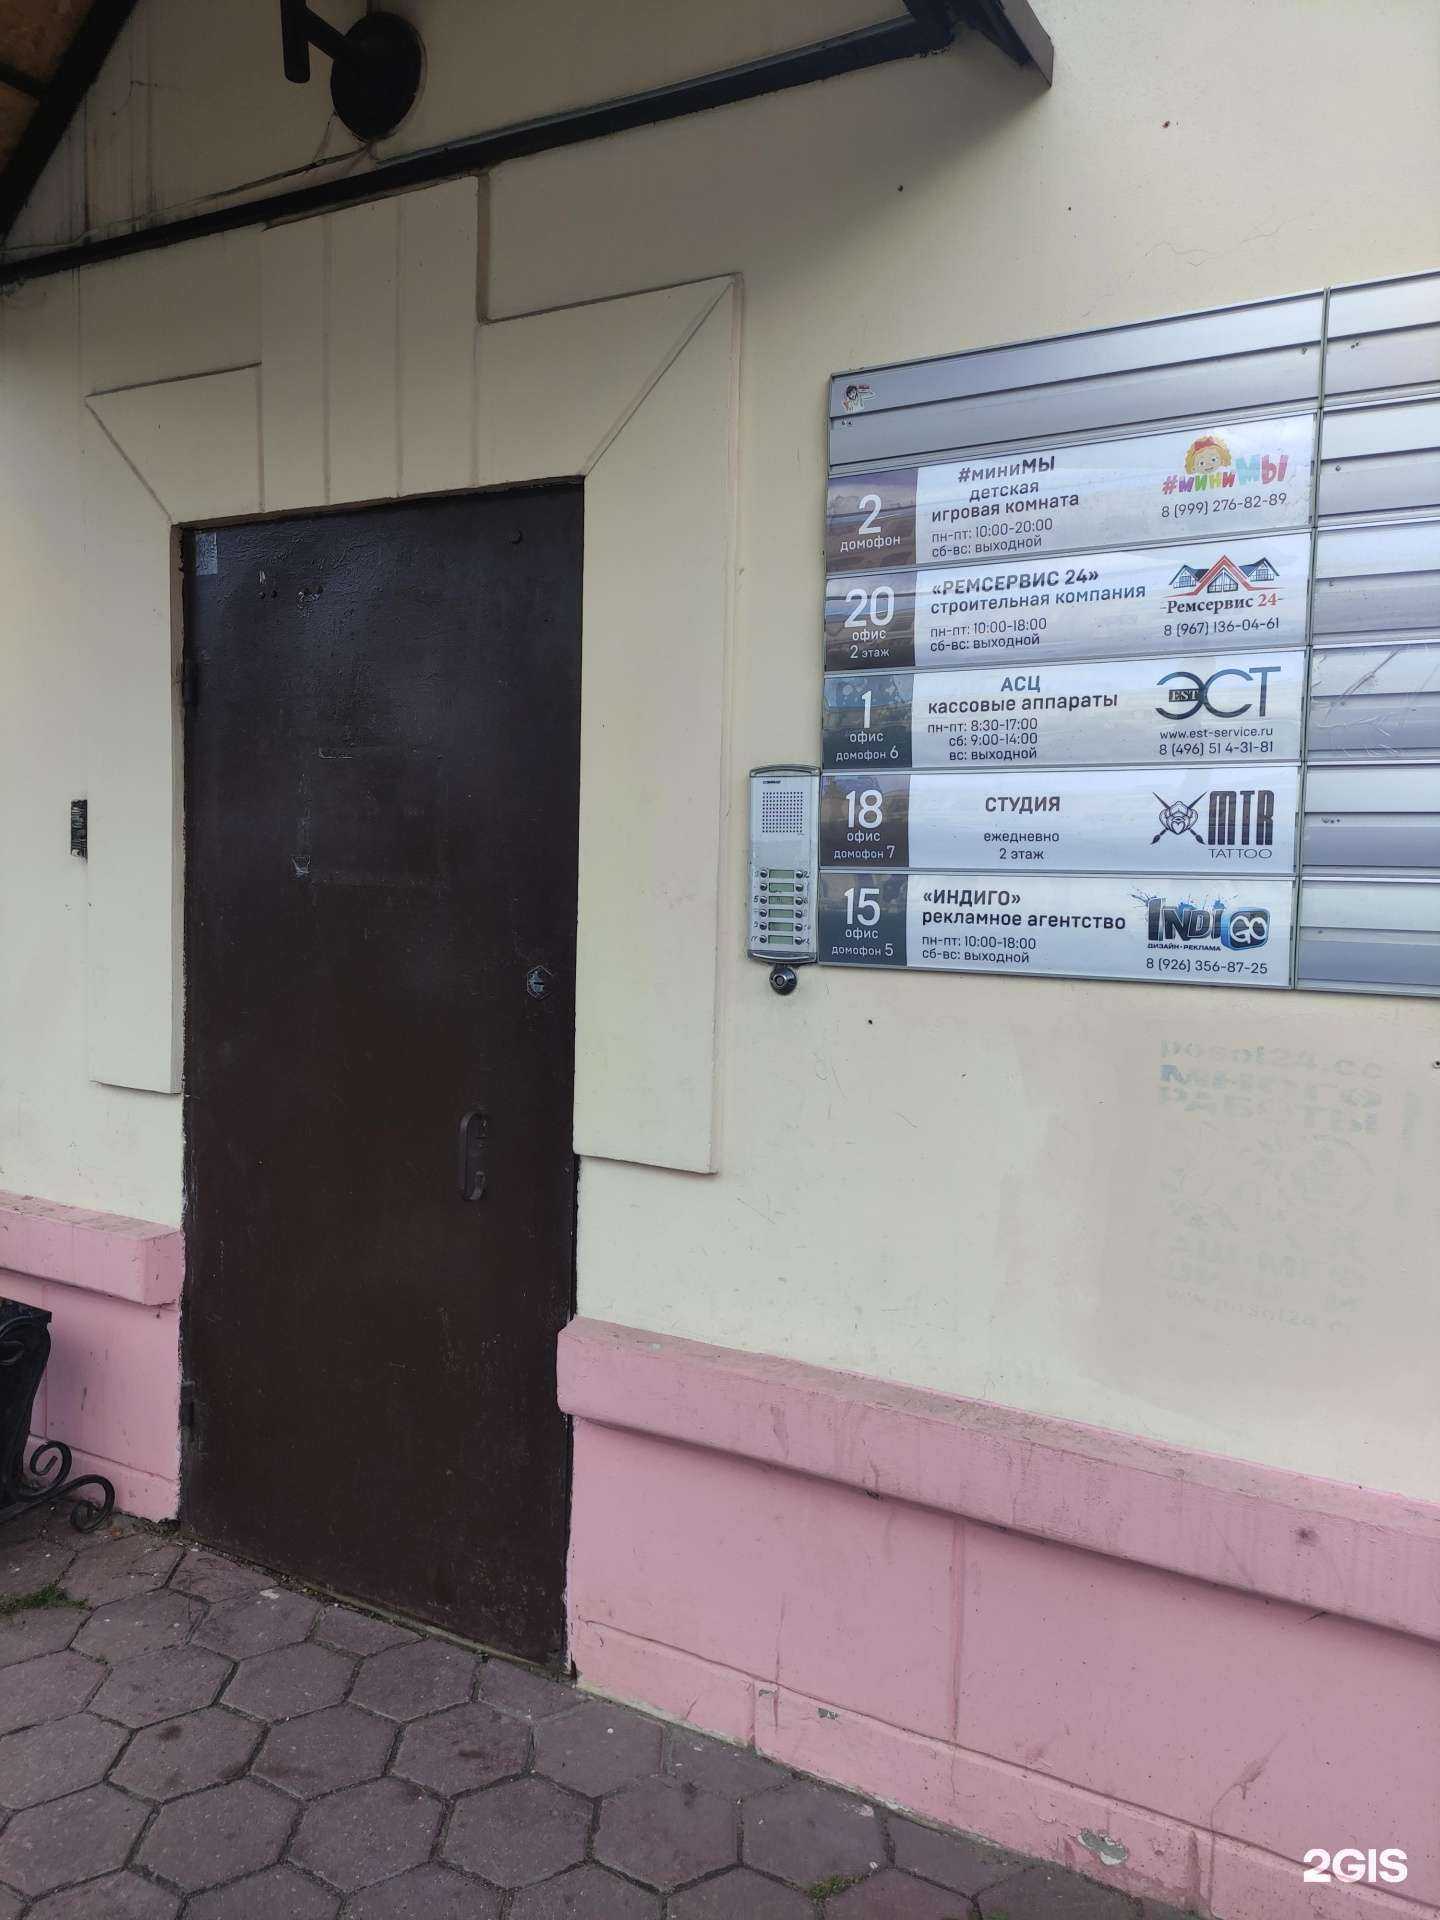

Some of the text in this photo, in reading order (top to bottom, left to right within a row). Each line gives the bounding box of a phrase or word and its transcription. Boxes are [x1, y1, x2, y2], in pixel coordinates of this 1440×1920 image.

[958, 455, 1055, 482] #миниМЫ
[969, 481, 1039, 503] детская
[858, 494, 882, 535] 2
[931, 494, 1079, 523] игровая комната
[1161, 492, 1287, 519] 8 (999) 276-82-89
[931, 518, 1053, 543] пн-пт: 10:00-20:00
[840, 535, 901, 553] домофон
[931, 535, 1042, 558] сб-вс: выходной
[931, 568, 1099, 596] «РЕМСЕРВИС 24»
[844, 585, 895, 628] 20
[930, 585, 1146, 616] строительная компания
[1167, 592, 1278, 614] Ремсервис 24
[852, 628, 888, 643] офис
[930, 617, 1047, 638] пн-пт: 10:00-18:00
[1163, 617, 1280, 637] 8 (967) 136-04-61
[850, 644, 890, 659] 2 этаж
[930, 633, 1041, 652] сб-вс: выходной
[1000, 675, 1041, 693] АСЦ
[928, 694, 1118, 714] кассовые аппараты
[1170, 689, 1200, 702] EST
[861, 690, 872, 729] 1
[927, 717, 1038, 734] пн-пт: 8:30-17:00
[1159, 727, 1273, 740] www.est-service.ru
[849, 730, 884, 743] офис
[949, 732, 1038, 747] сб: 9:00-14:00
[835, 745, 899, 761] домофон 6
[949, 746, 1037, 761] вс: выходной
[1159, 743, 1168, 756] 8
[1171, 743, 1204, 757] (496)
[845, 789, 883, 829] 18
[985, 796, 1061, 815] СТУДИЯ
[846, 830, 881, 843] офис
[983, 831, 1060, 844] ежедневно
[833, 845, 896, 860] домофон 7
[999, 847, 1045, 860] 2 этаж
[1207, 848, 1273, 859] TATTOO
[844, 887, 881, 926] 15
[922, 888, 1021, 908] «ИНДИГО»
[922, 911, 1126, 930] рекламное агентство
[844, 928, 879, 940] офис
[922, 935, 1037, 950] пн-пт: 10:00-18:00
[831, 943, 894, 957] домофон 5
[922, 948, 1030, 964] сб-вс: выходной
[1146, 957, 1268, 974] 8 (926) 356-87-25
